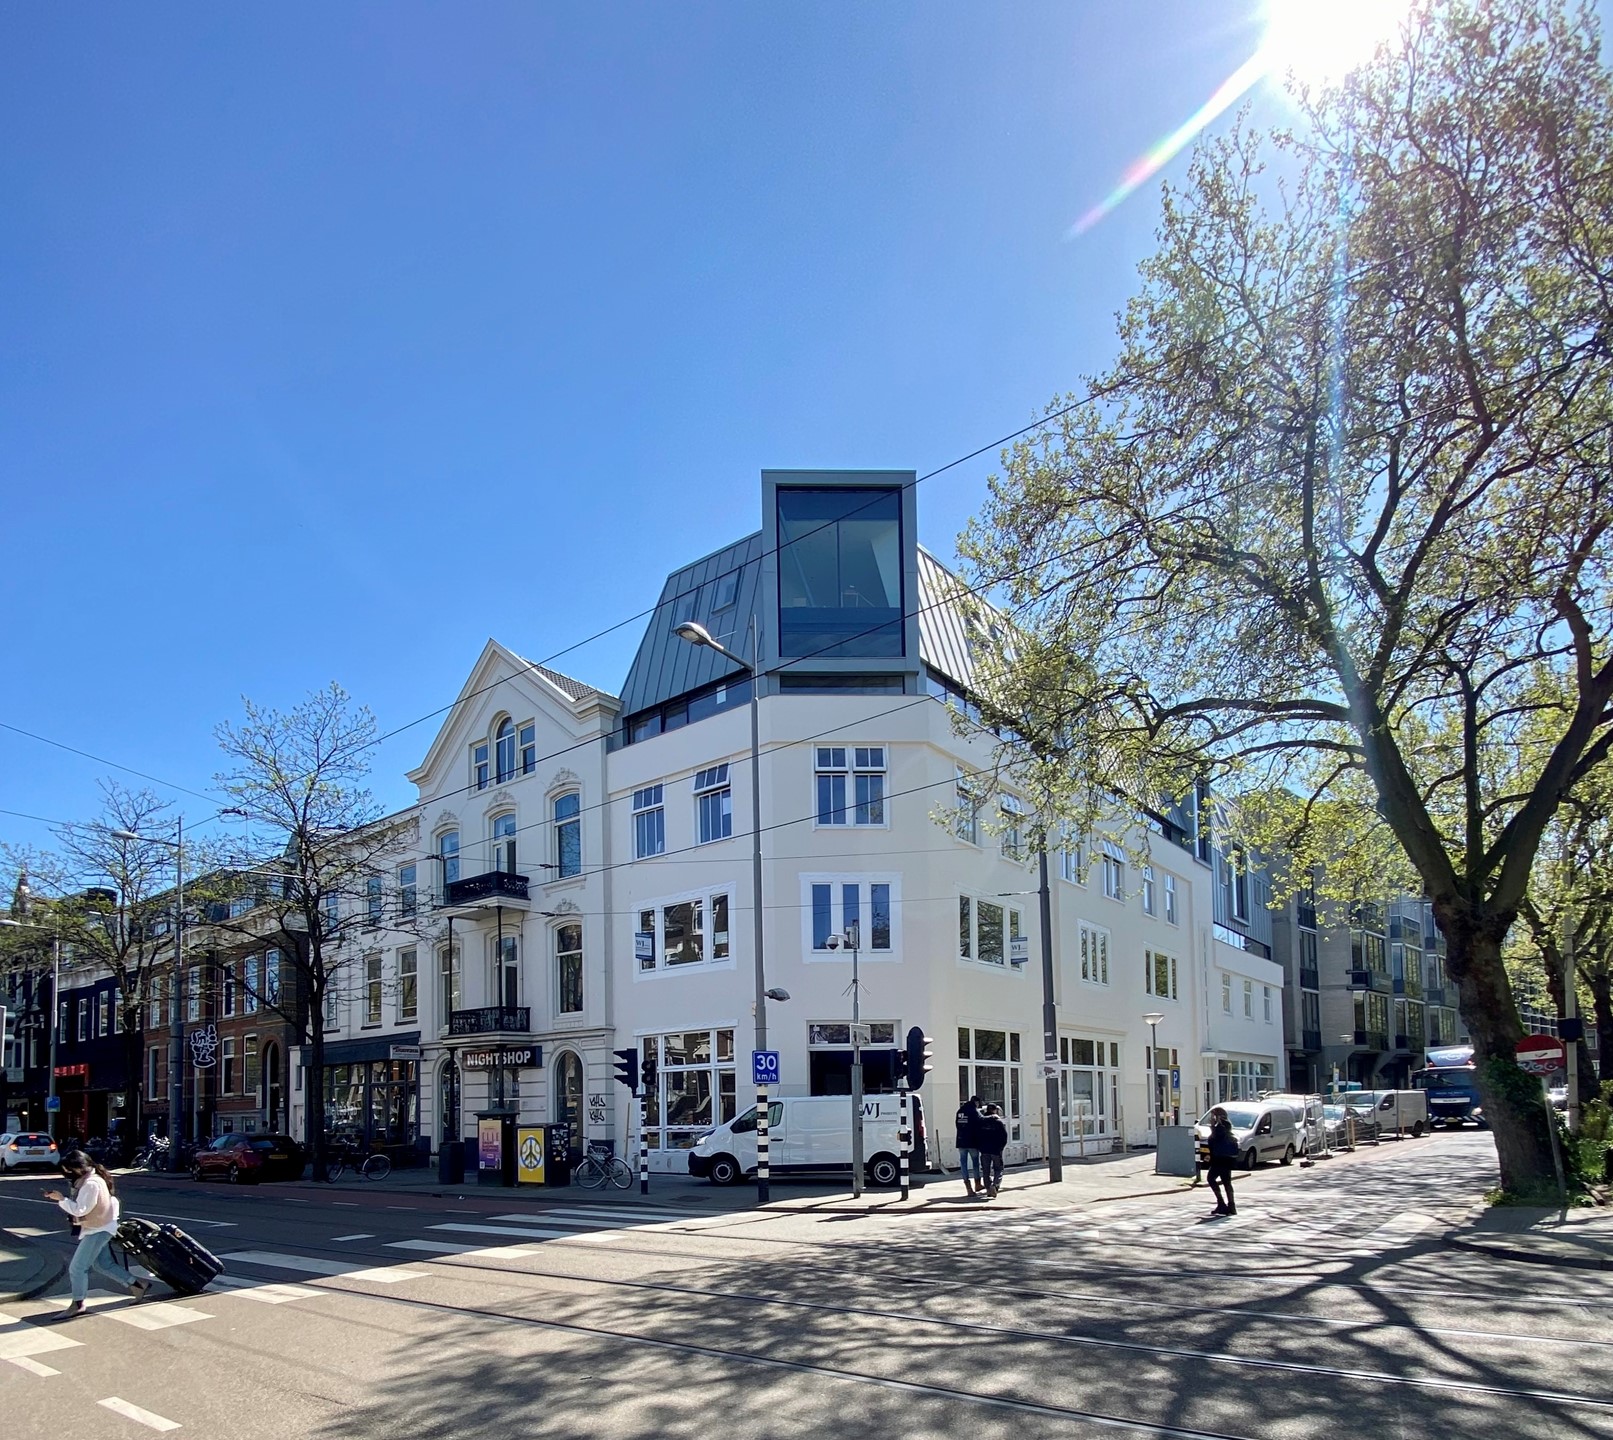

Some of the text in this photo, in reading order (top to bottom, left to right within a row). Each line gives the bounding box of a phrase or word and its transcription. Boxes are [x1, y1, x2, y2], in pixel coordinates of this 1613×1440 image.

[467, 1051, 531, 1066] NIGHT SHOP
[756, 1054, 777, 1070] 30
[756, 1072, 777, 1081] km/h
[1173, 1071, 1178, 1087] P
[861, 1102, 880, 1118] WJ
